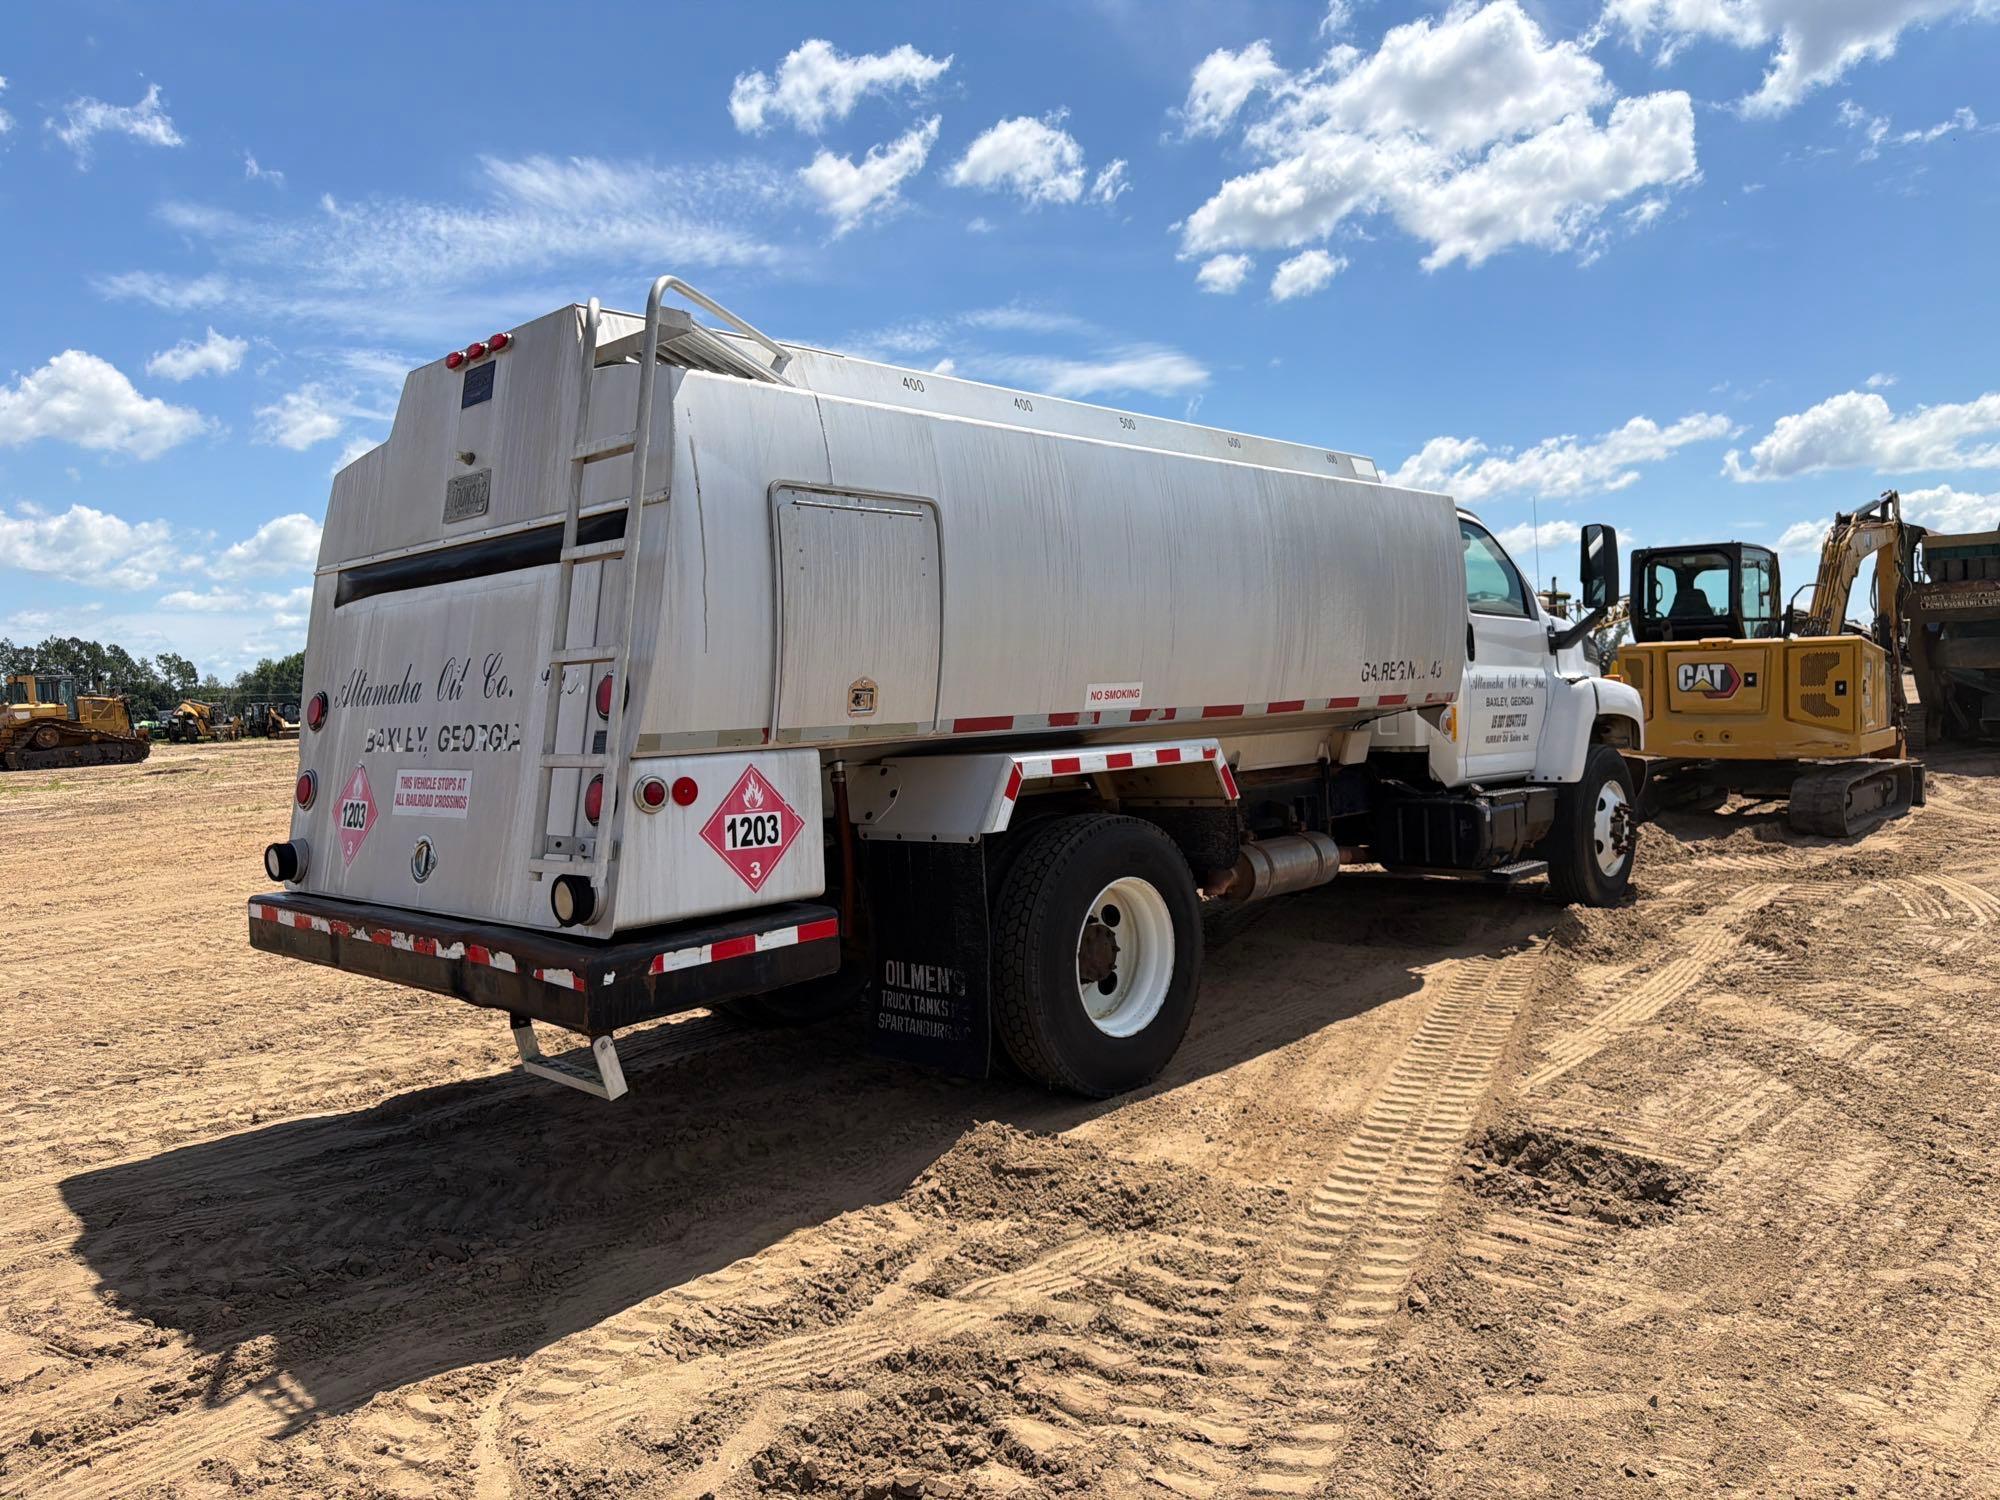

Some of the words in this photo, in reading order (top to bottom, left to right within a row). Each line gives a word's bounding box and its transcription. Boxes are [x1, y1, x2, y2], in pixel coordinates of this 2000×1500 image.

[902, 376, 926, 393] 400
[1013, 397, 1034, 413] 400
[1118, 416, 1136, 431] 500
[1226, 436, 1242, 449] 600
[1325, 453, 1338, 465] 600
[334, 663, 423, 709] Altamaha
[436, 656, 472, 702] Oil
[483, 652, 514, 699] Co.
[1677, 663, 1726, 692] CAT
[1090, 690, 1103, 701] NO
[1104, 688, 1140, 701] SMOKING
[1485, 696, 1509, 708] BAXLEY,
[1510, 695, 1534, 707] GEORGIA
[364, 725, 429, 759] BAXLEY,
[438, 723, 521, 752] GEORGIA
[400, 776, 413, 790] THIS
[413, 776, 437, 791] VEHICLE
[438, 777, 457, 792] STOPS
[457, 777, 467, 792] AT
[394, 793, 405, 806] ALL
[405, 793, 434, 808] RAILROAD
[433, 794, 468, 810] CROSSINGS
[342, 801, 367, 830] 1203
[726, 814, 780, 849] 1203
[346, 840, 353, 855] 3
[749, 861, 762, 879] 3
[881, 989, 912, 1012] TRUCK
[912, 995, 949, 1017] TANKS
